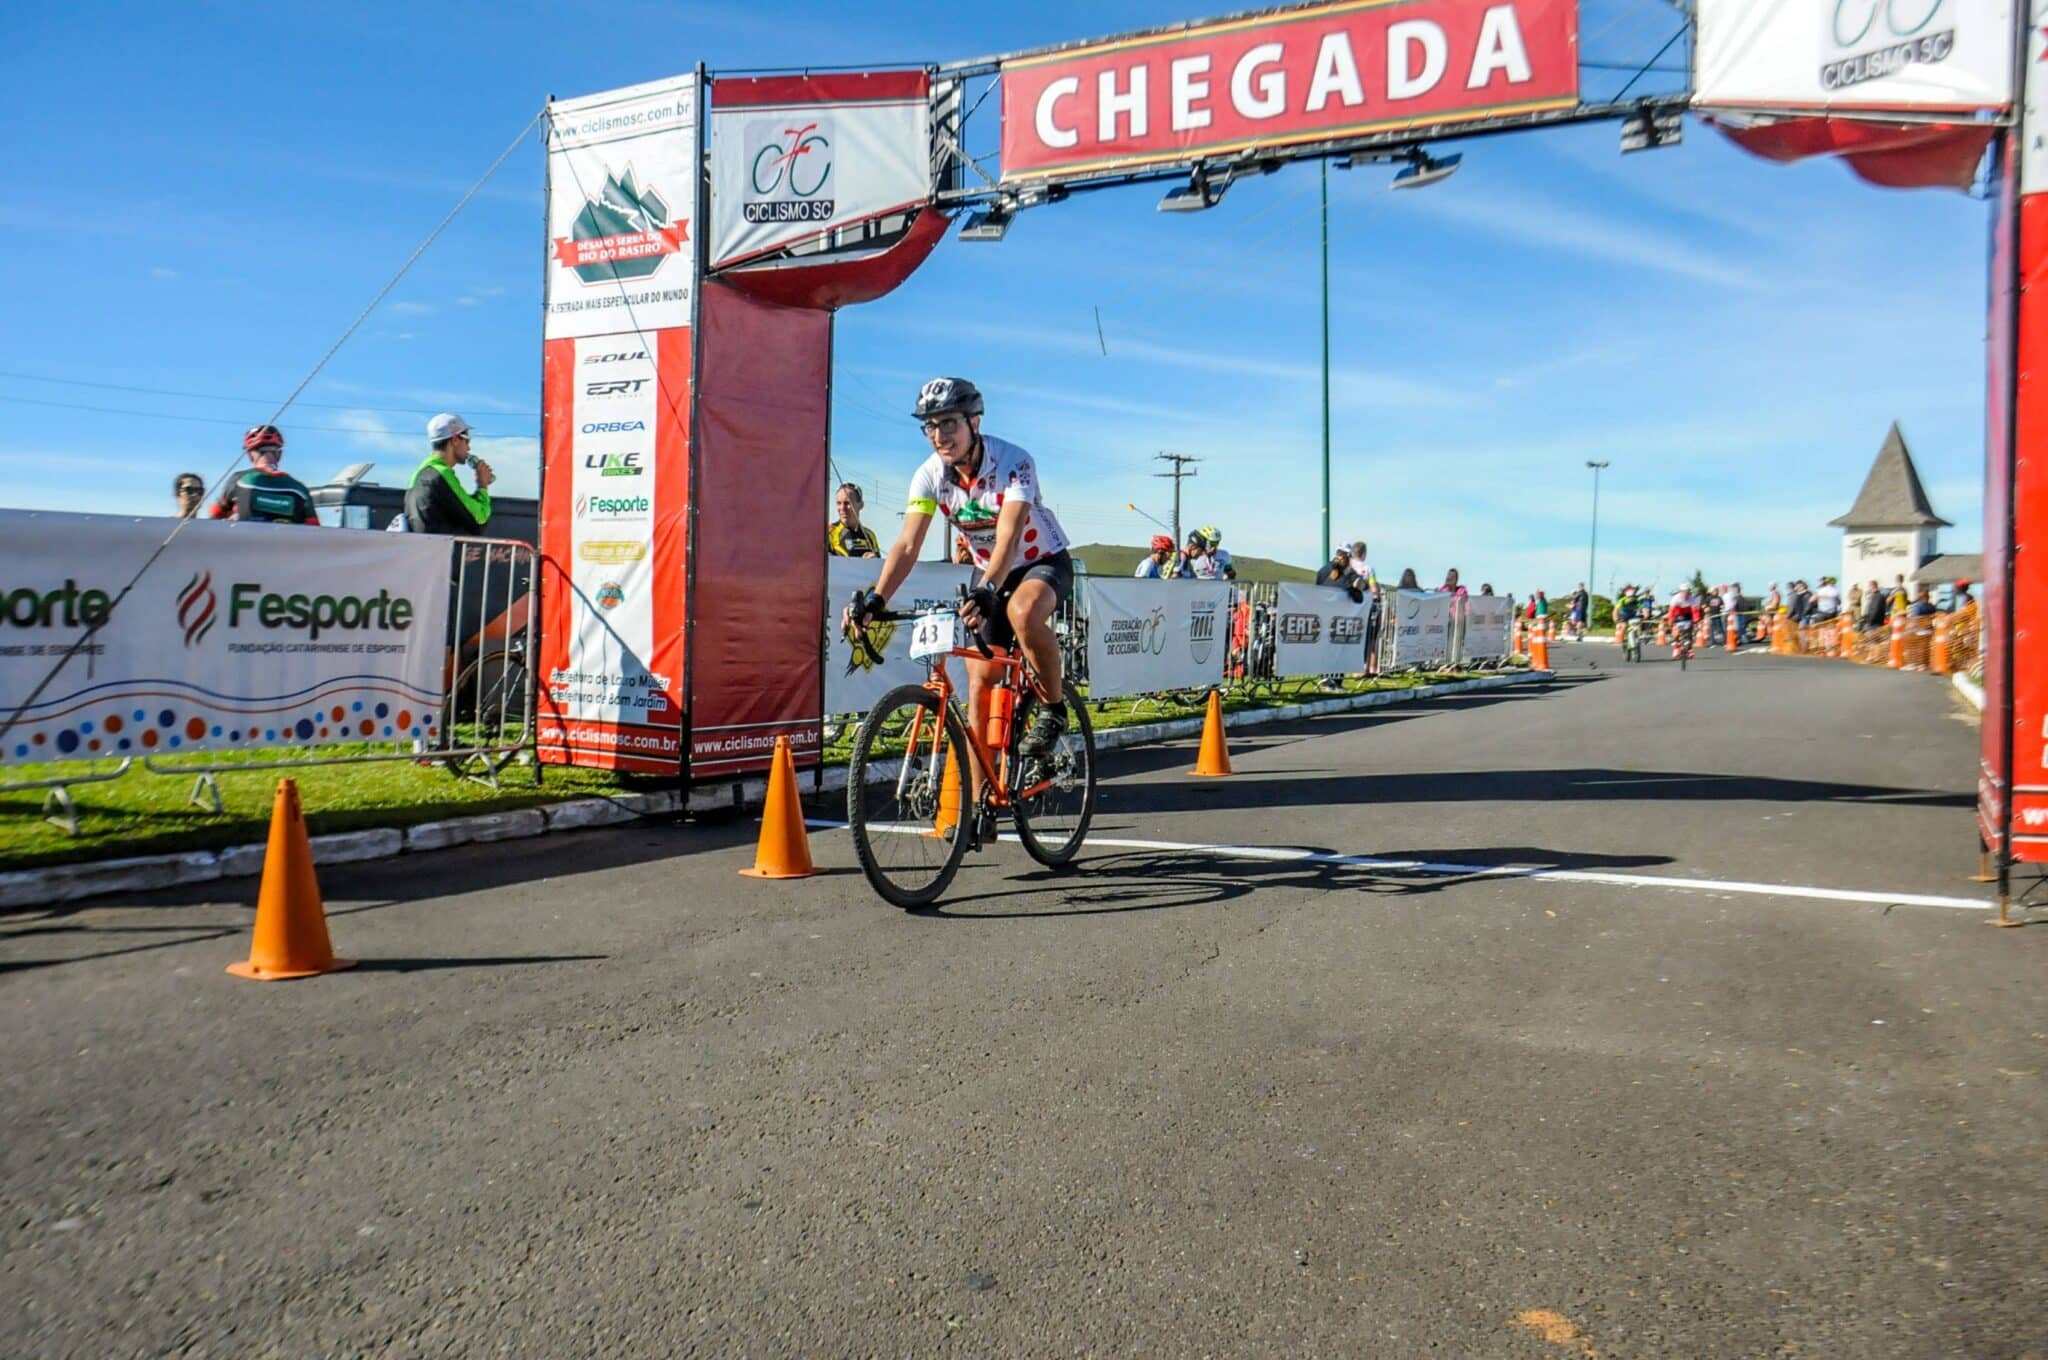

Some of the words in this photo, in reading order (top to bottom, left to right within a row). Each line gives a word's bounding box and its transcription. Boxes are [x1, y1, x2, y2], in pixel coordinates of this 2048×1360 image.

[1822, 46, 1915, 89] CICLISMO
[1919, 34, 1951, 64] SC
[1034, 3, 1534, 149] CHEGADA
[745, 201, 810, 221] CICLISMO
[812, 201, 832, 219] SC
[578, 249, 597, 262] RIO
[599, 247, 616, 259] DO
[618, 242, 661, 257] RASTRO
[662, 288, 689, 302] MUNDO
[583, 351, 652, 365] SOUL
[586, 378, 652, 396] ERT
[581, 420, 646, 434] ORBEA
[585, 452, 641, 469] LIKE
[589, 495, 649, 517] Fesporte
[0, 578, 111, 630] orte
[228, 583, 415, 641] Fesporte
[919, 624, 939, 646] 43
[352, 644, 363, 654] DE
[366, 644, 407, 655] ESPORTE
[595, 673, 608, 685] de
